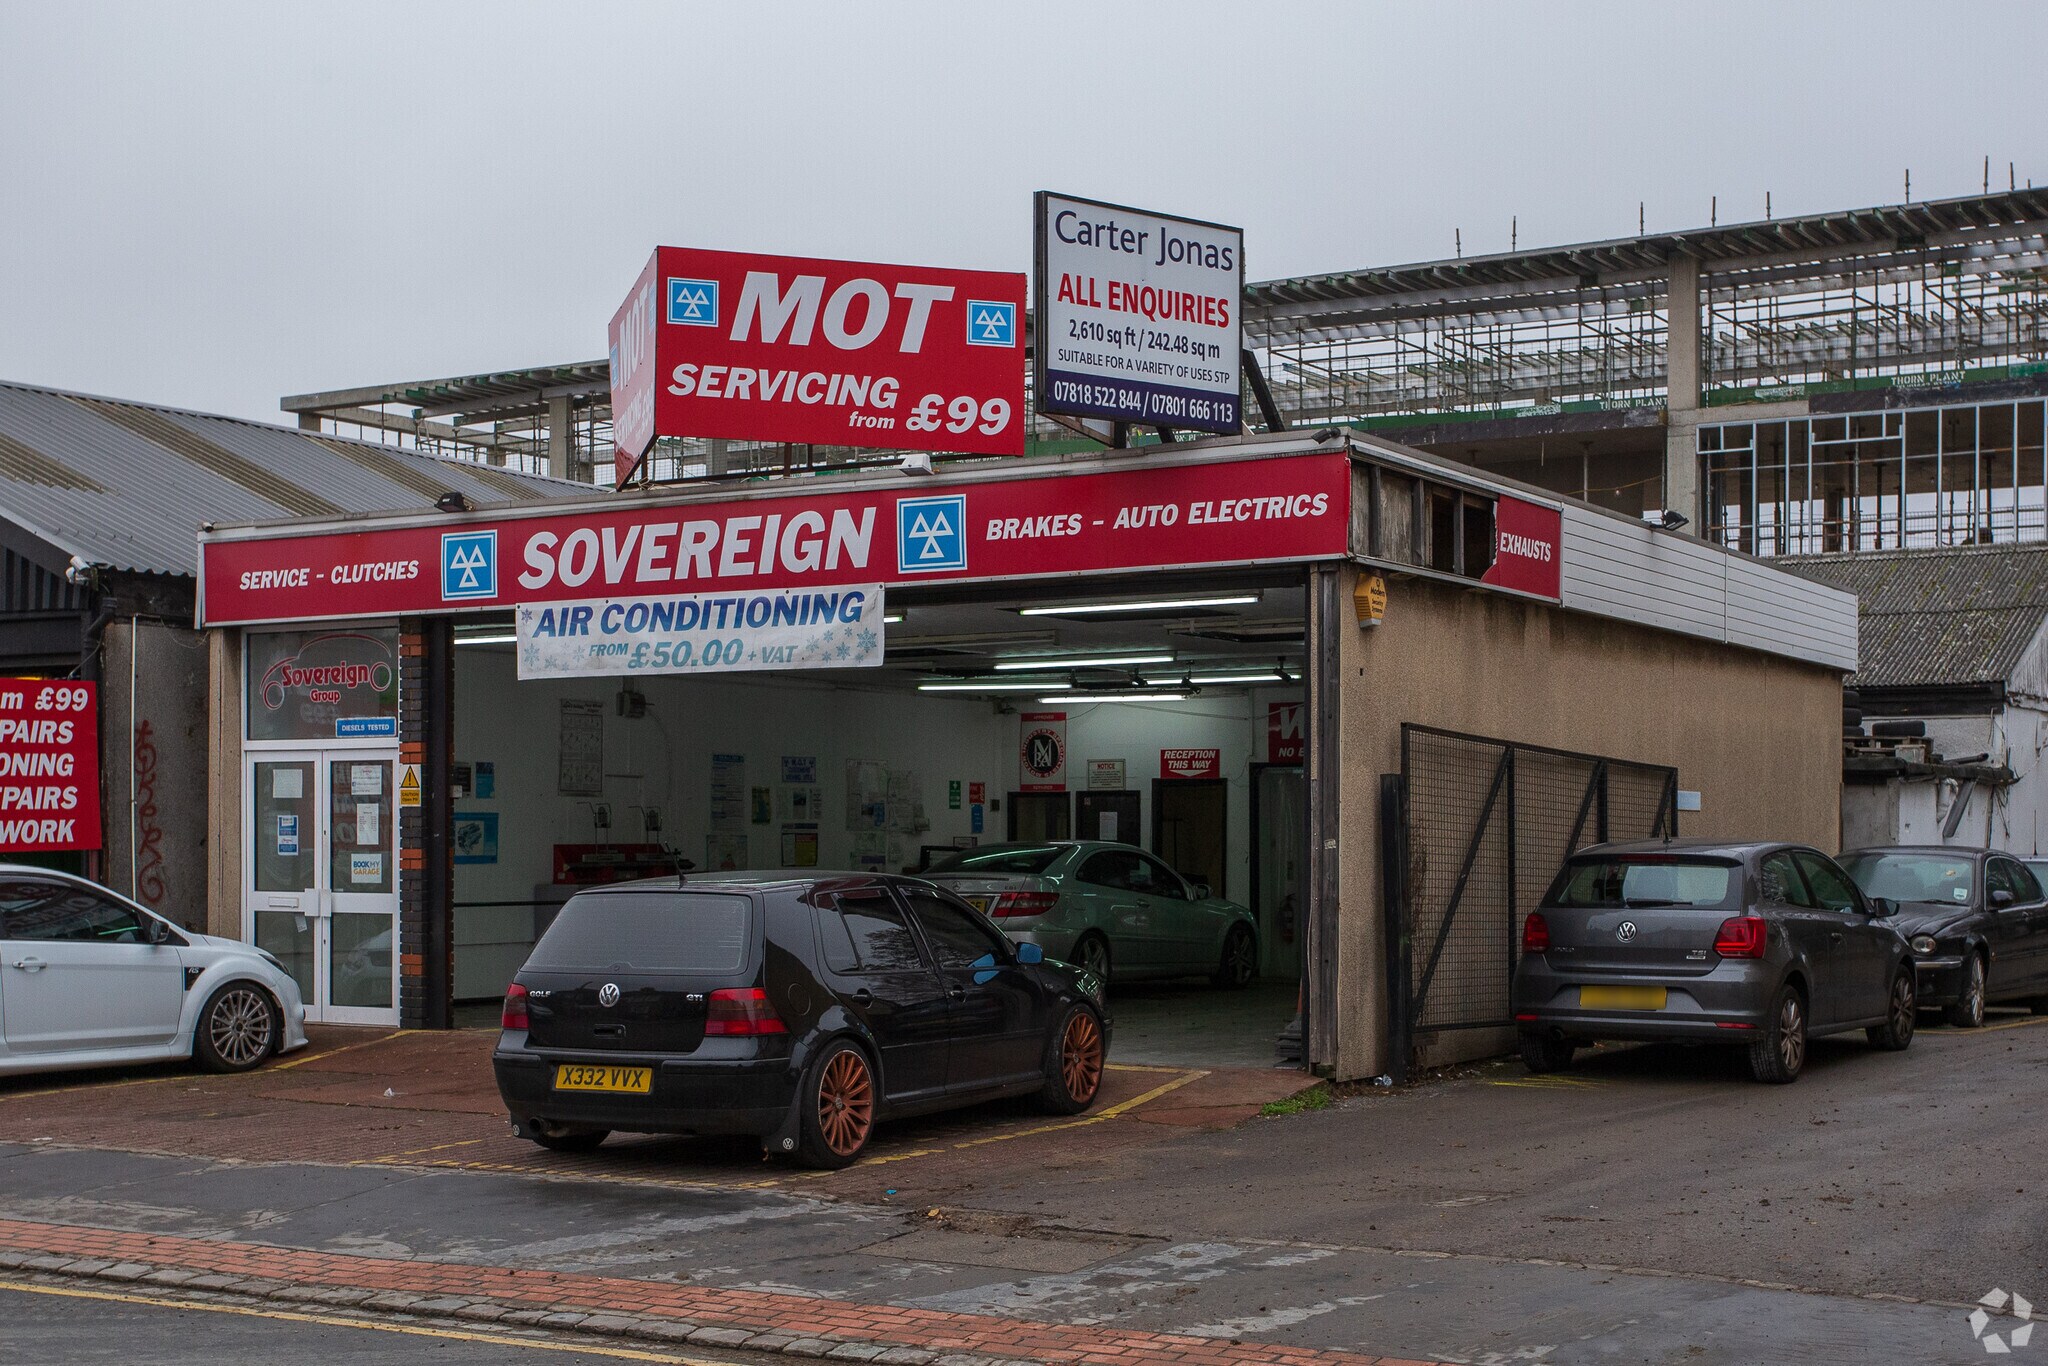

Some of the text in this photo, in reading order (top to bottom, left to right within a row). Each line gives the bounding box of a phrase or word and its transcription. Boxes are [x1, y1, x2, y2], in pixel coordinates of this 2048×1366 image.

[1055, 210, 1233, 271] Carter Jonas
[730, 271, 956, 354] MOT
[1057, 273, 1229, 328] ALL ENQUIRIES
[620, 282, 648, 392] MOT
[1069, 319, 1220, 361] 2,610 sq ft / 242.48 sq m
[1058, 348, 1230, 384] SUITABLE FOR A VARIETY OF USES STP
[1890, 374, 1925, 386] THORN
[1930, 370, 1966, 382] PLANT
[667, 363, 900, 409] SERVICING
[849, 394, 1012, 436] from £99
[1054, 380, 1232, 423] 07818 522 844 / 07801 666 113
[986, 513, 1082, 541] BRAKES
[1113, 503, 1178, 530] AUTO
[1187, 492, 1329, 526] ELECTRICS
[517, 506, 876, 590] SOVEREIGN
[1500, 532, 1552, 562] EXHAUSTS
[240, 568, 310, 590] SERVICE
[330, 560, 419, 584] CLUTCHES
[532, 590, 866, 638] AIR CONDITIONING
[588, 638, 798, 669] FROM £50.00 + VAT
[281, 661, 369, 688] Sovereign
[34, 687, 88, 712] £99
[310, 689, 341, 704] Group
[0, 720, 74, 744] PAIRS
[342, 724, 365, 732] DIESELS
[0, 752, 74, 777] ONING
[1164, 750, 1216, 760] RECEPTION
[1168, 760, 1212, 769] THIS WAY
[1278, 747, 1294, 757] NO
[0, 786, 78, 810] PAIRS
[0, 818, 76, 844] WORK
[529, 990, 551, 998] GOLF
[686, 994, 704, 1002] GTI
[562, 1066, 644, 1088] X332 VVX
